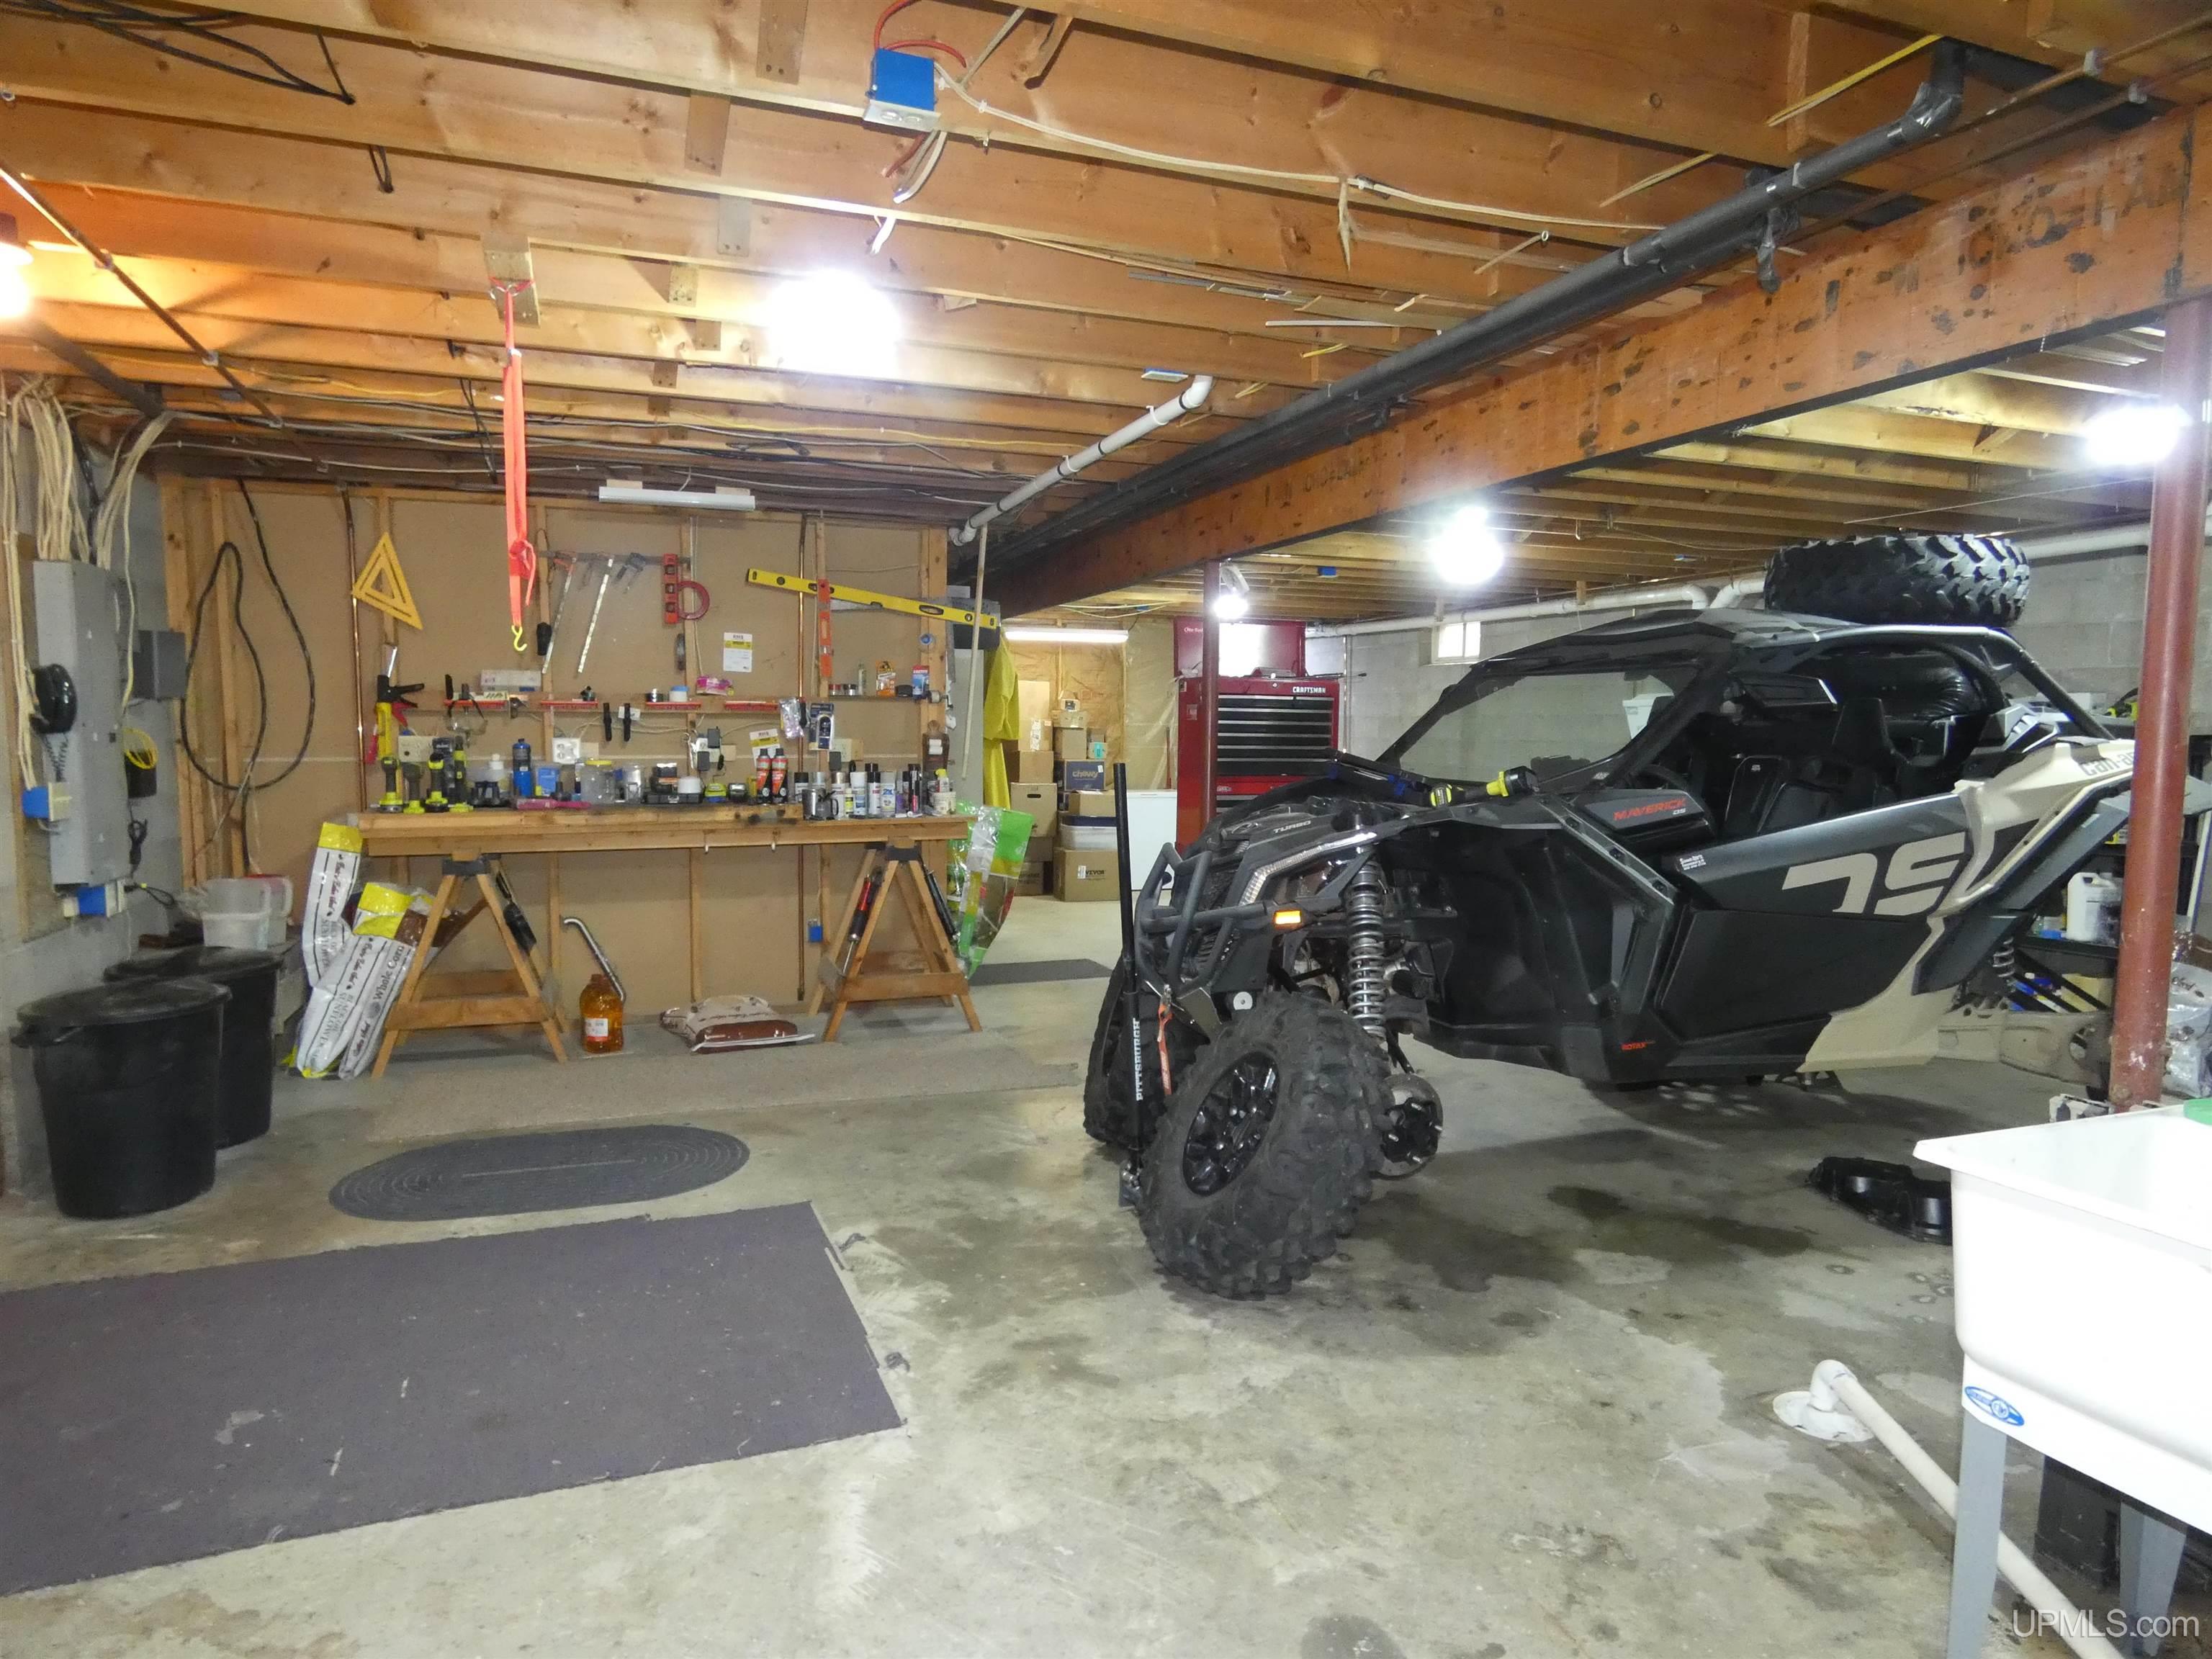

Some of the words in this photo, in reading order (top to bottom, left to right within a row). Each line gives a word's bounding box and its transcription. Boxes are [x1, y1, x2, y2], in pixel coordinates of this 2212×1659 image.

[1273, 820, 1311, 833] TURBO
[1613, 798, 1686, 821] MAVERICK
[373, 971, 393, 1002] Whole
[387, 945, 405, 969] Corn
[1132, 1017, 1143, 1101] PITTSBURGH
